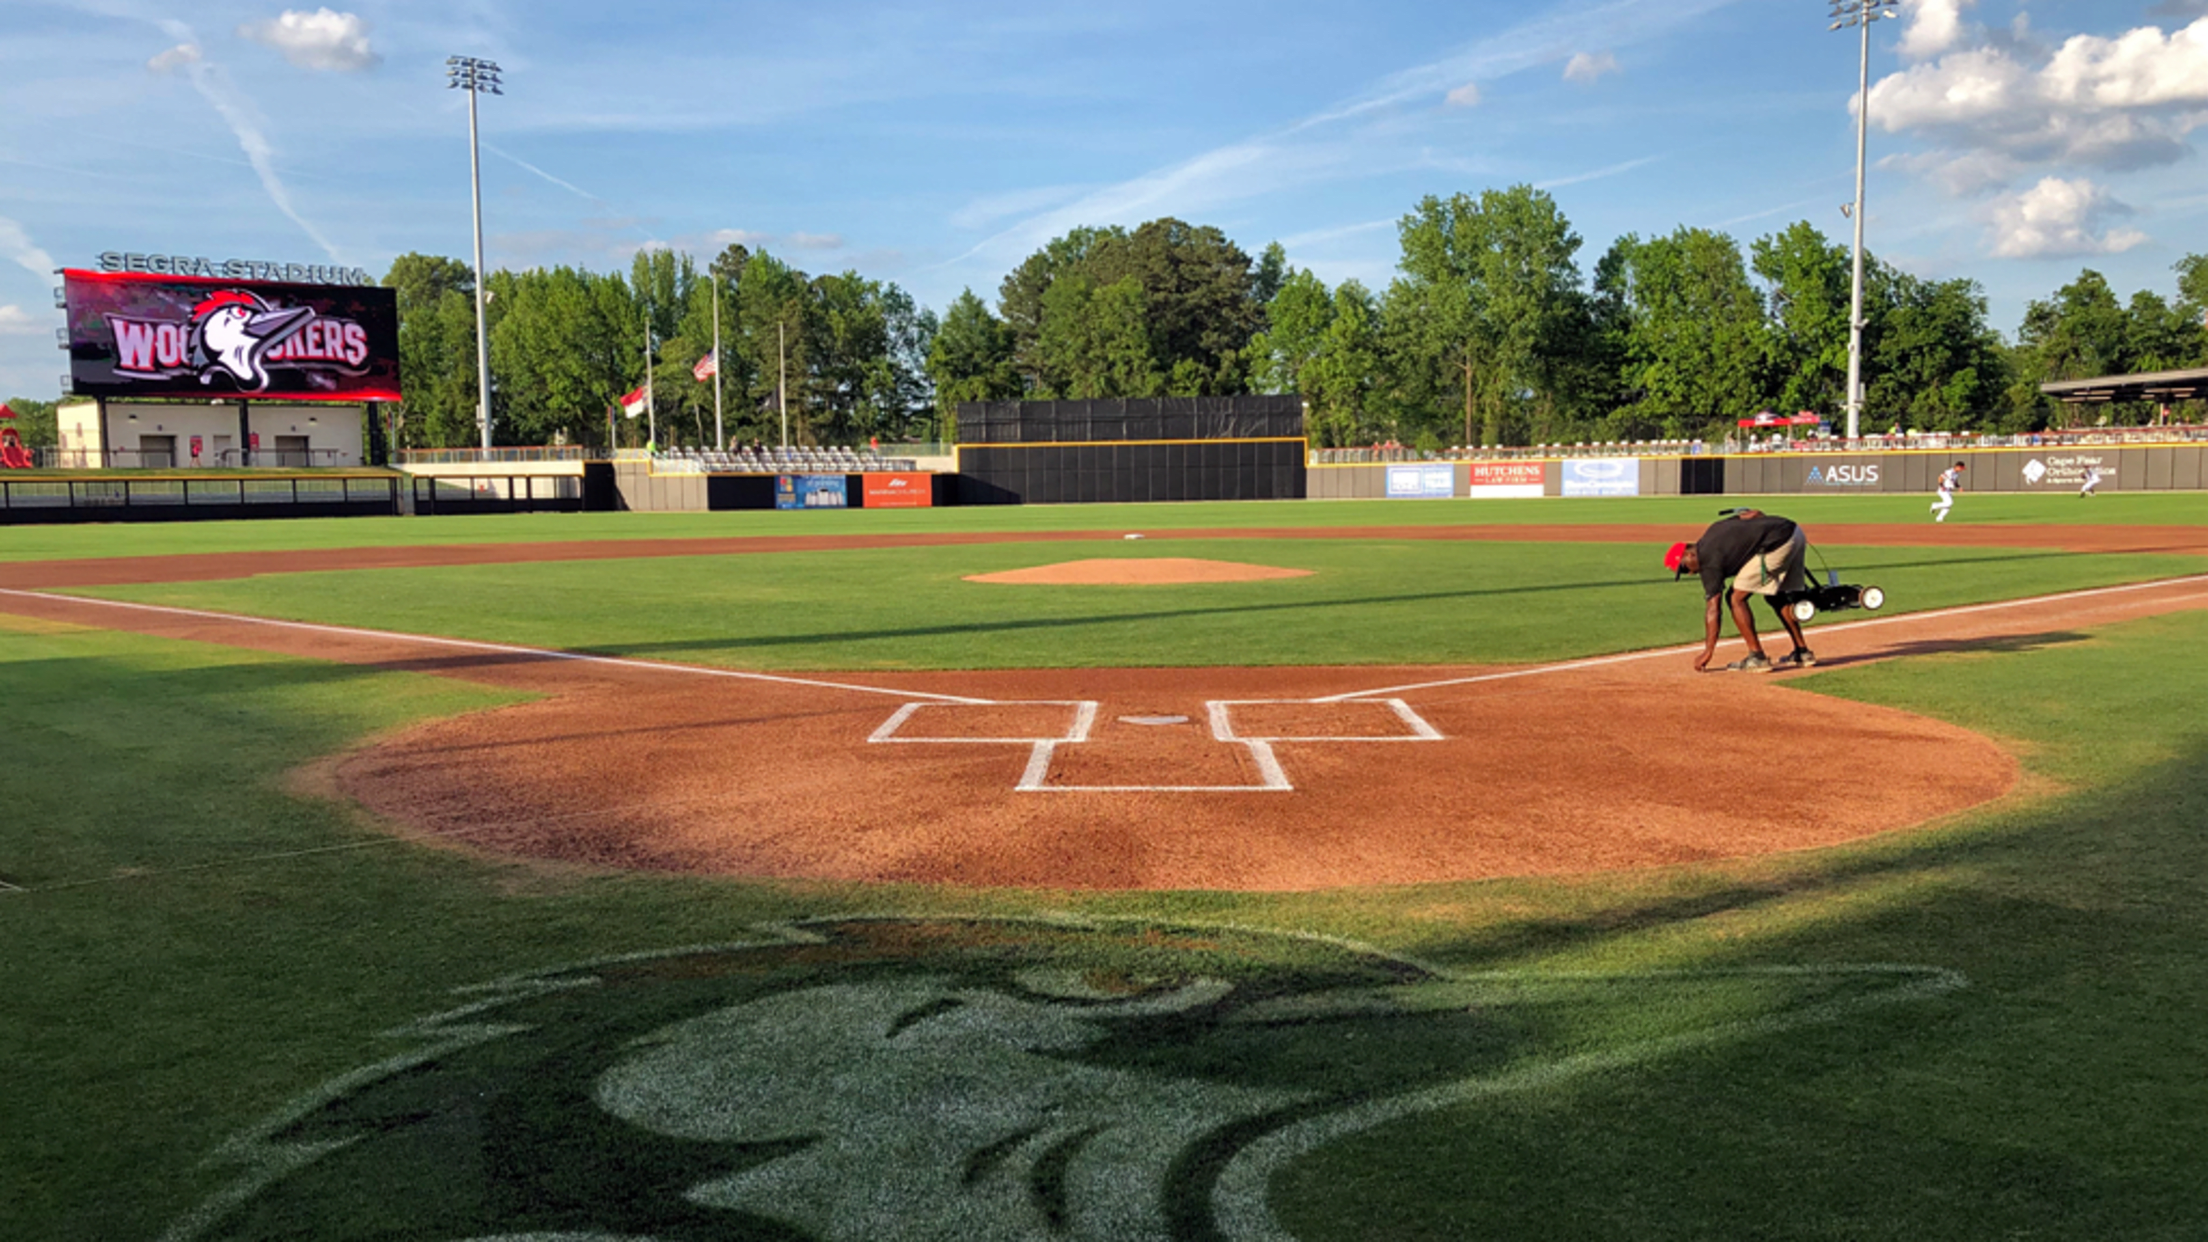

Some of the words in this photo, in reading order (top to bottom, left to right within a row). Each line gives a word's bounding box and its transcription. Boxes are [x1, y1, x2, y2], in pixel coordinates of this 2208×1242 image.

[101, 252, 214, 277] SEGRA
[225, 259, 366, 286] STADIUM
[2046, 456, 2075, 466] Cape
[1474, 465, 1540, 477] HUTCHENS
[1826, 465, 1879, 482] ASUS
